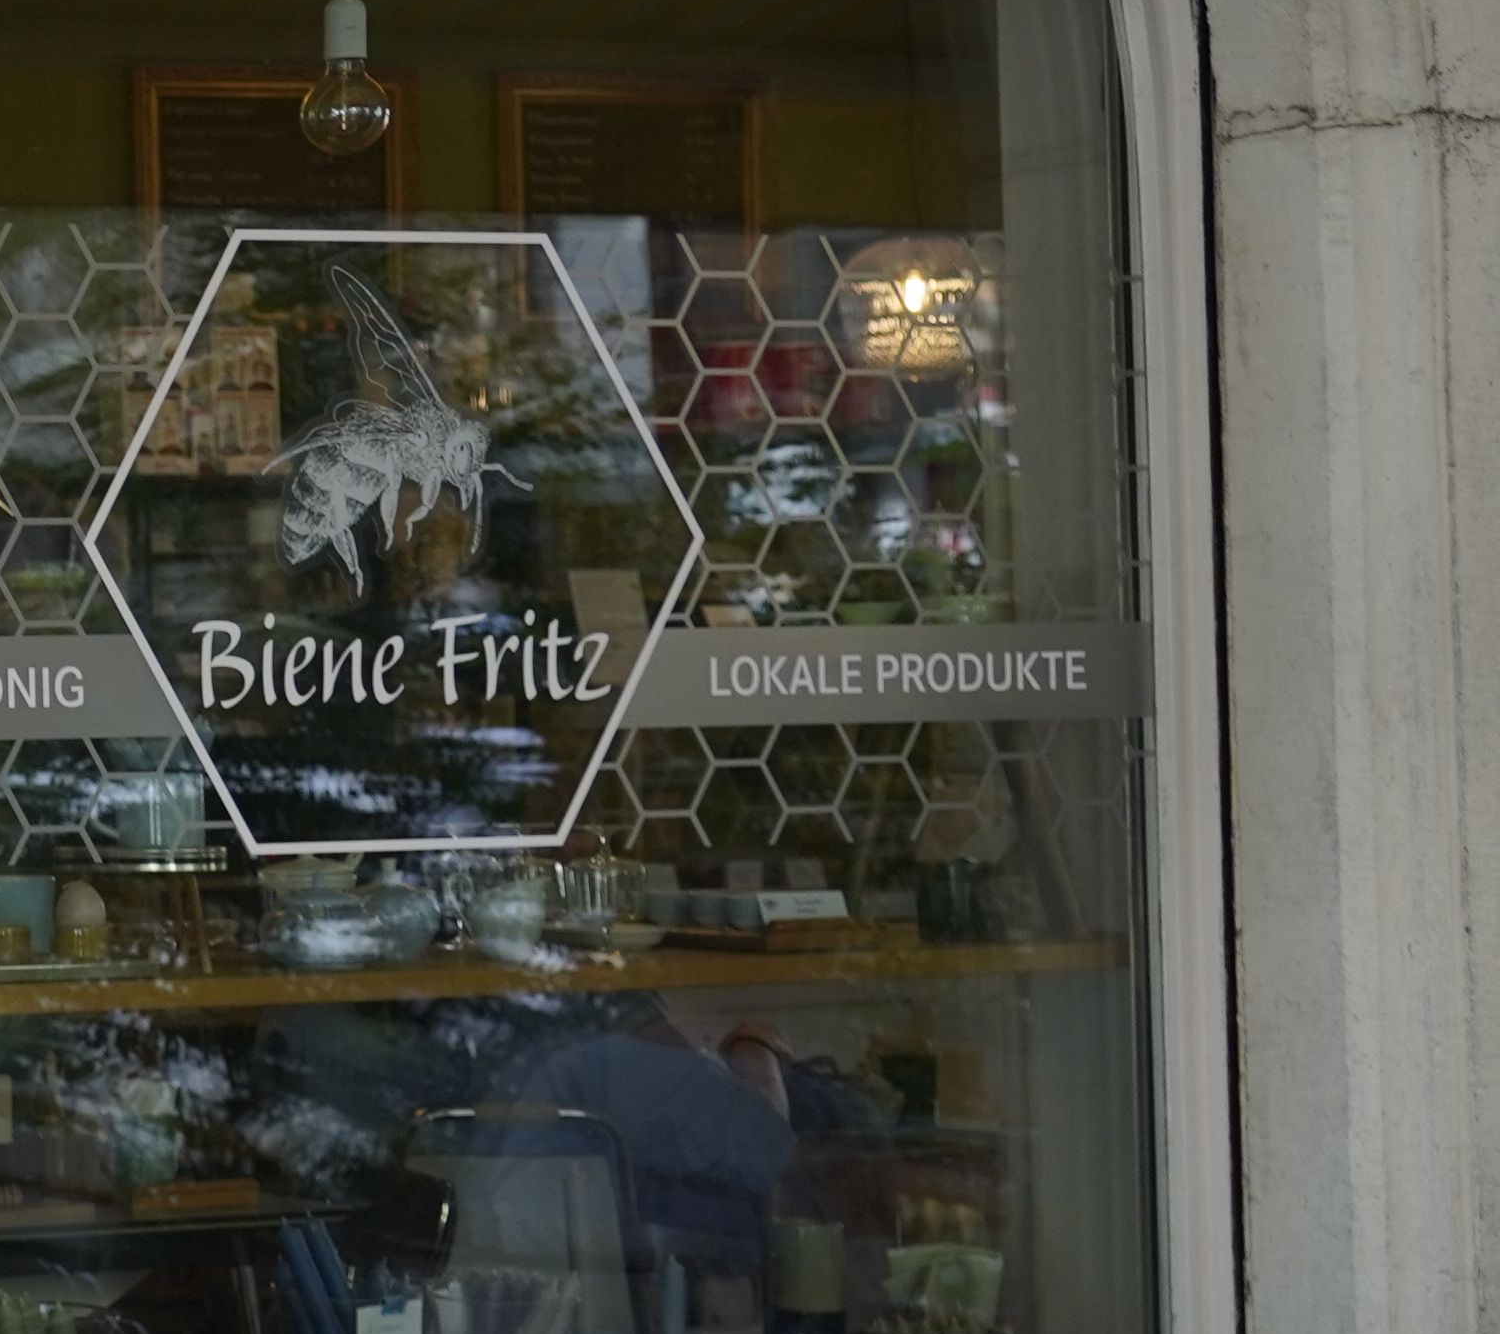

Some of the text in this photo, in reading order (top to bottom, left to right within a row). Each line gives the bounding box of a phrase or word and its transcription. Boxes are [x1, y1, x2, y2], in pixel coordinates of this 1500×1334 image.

[191, 608, 612, 709] Biene Fritz
[708, 649, 1089, 698] LOKALE PRODUKTE
